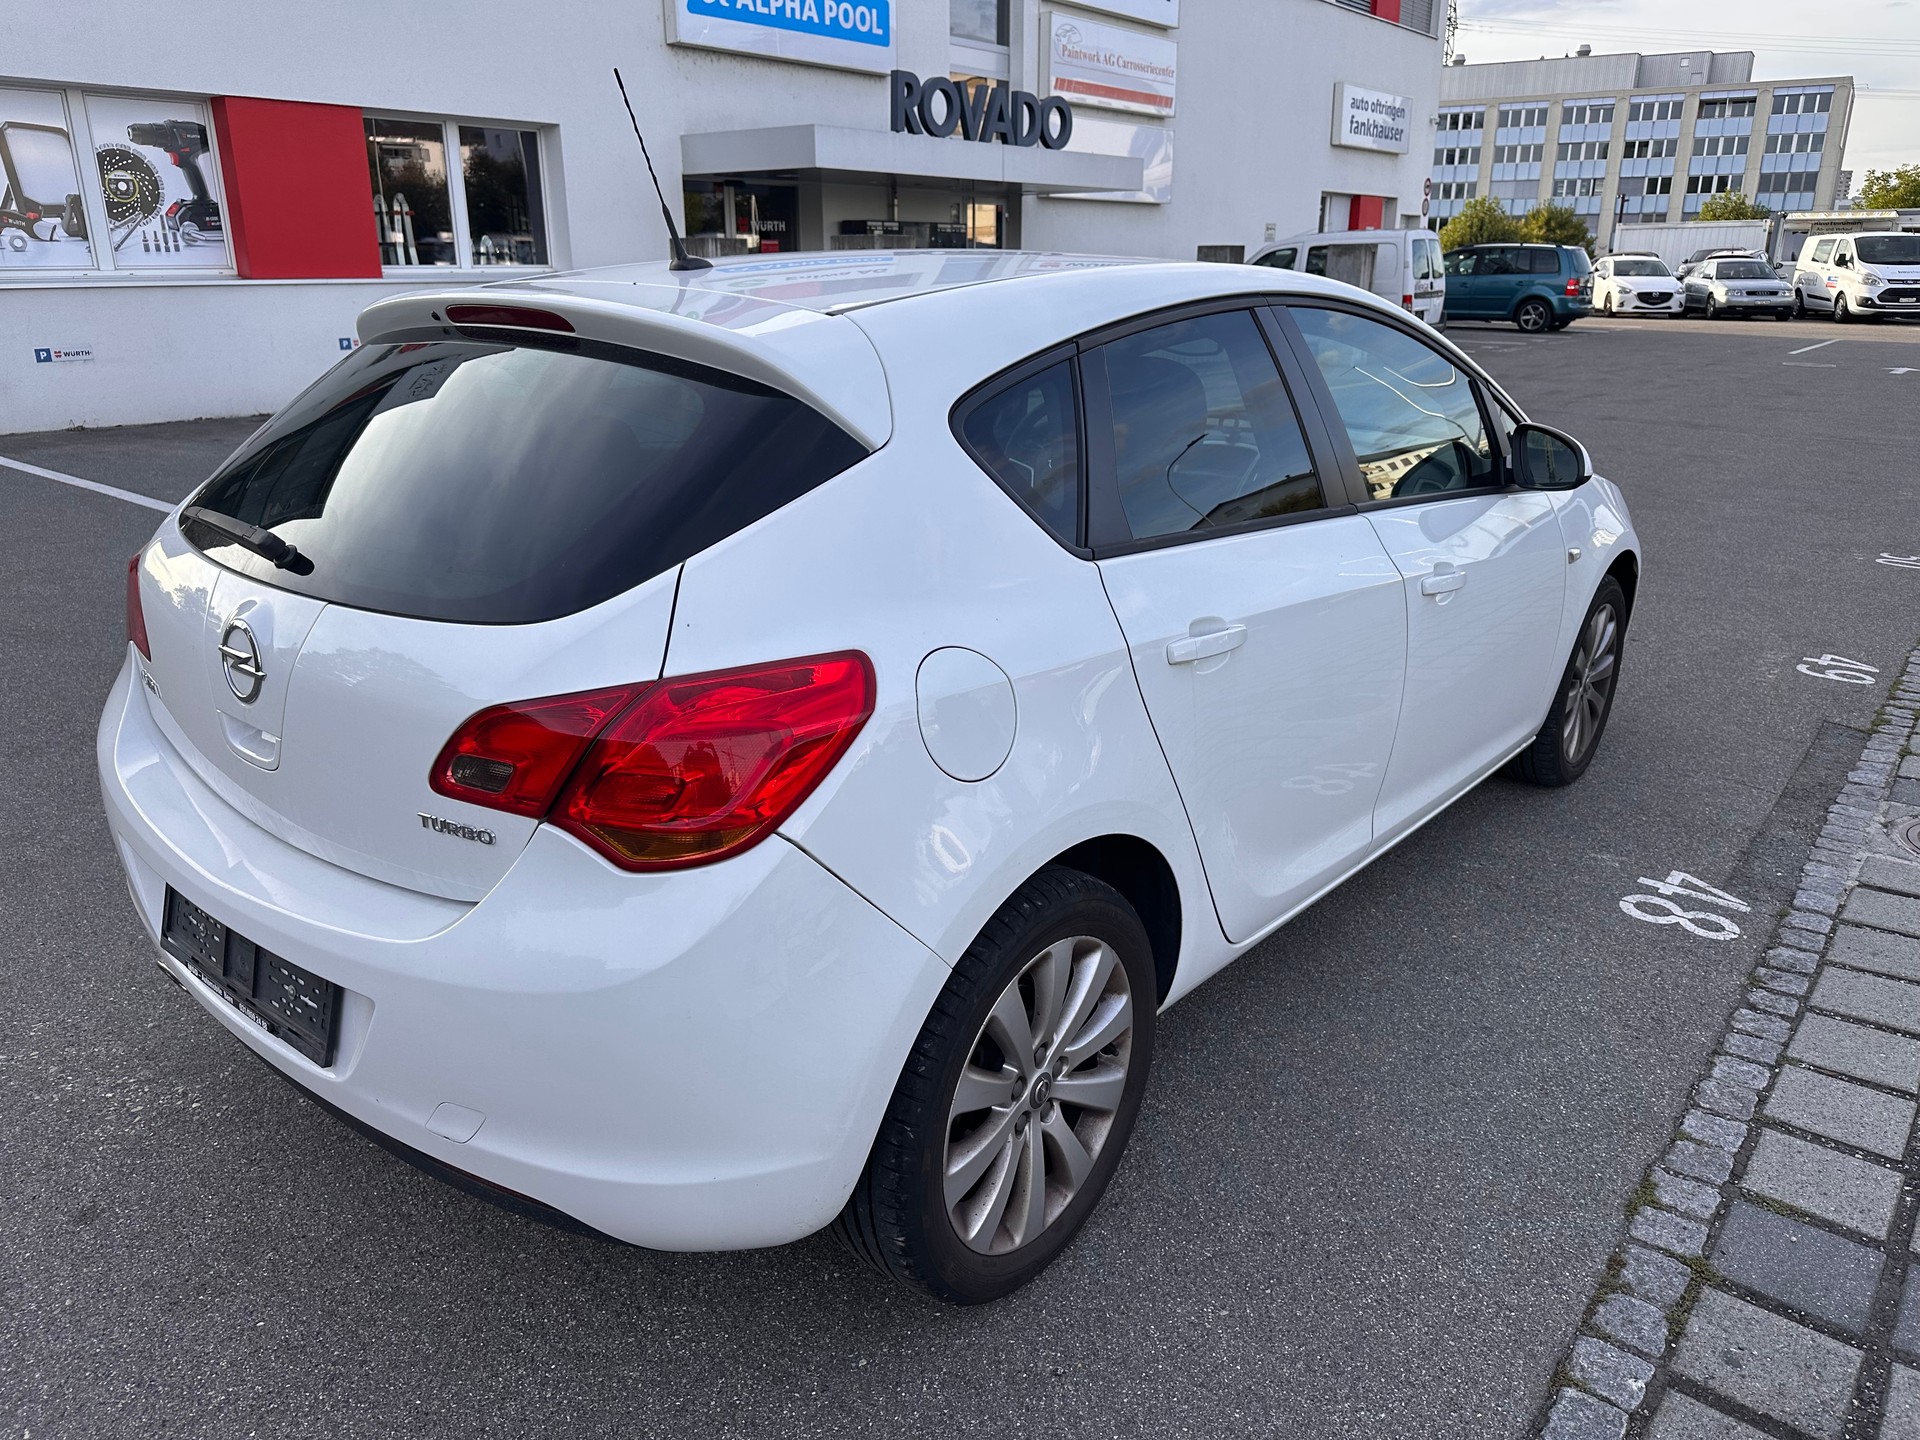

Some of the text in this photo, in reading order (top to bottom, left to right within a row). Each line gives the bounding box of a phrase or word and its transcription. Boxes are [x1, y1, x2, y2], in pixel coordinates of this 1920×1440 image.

[824, 0, 883, 35] POOL
[1062, 44, 1175, 78] Paintwork AG Carrosseriecenter
[890, 70, 1073, 150] ROVADO
[1350, 97, 1406, 121] auto oftringen
[1349, 114, 1404, 142] fankhauser
[751, 220, 786, 232] WÜRTH
[63, 350, 90, 358] WÜRTH
[1796, 653, 1880, 685] 49
[417, 811, 497, 845] TURBO
[1619, 870, 1752, 941] 48
